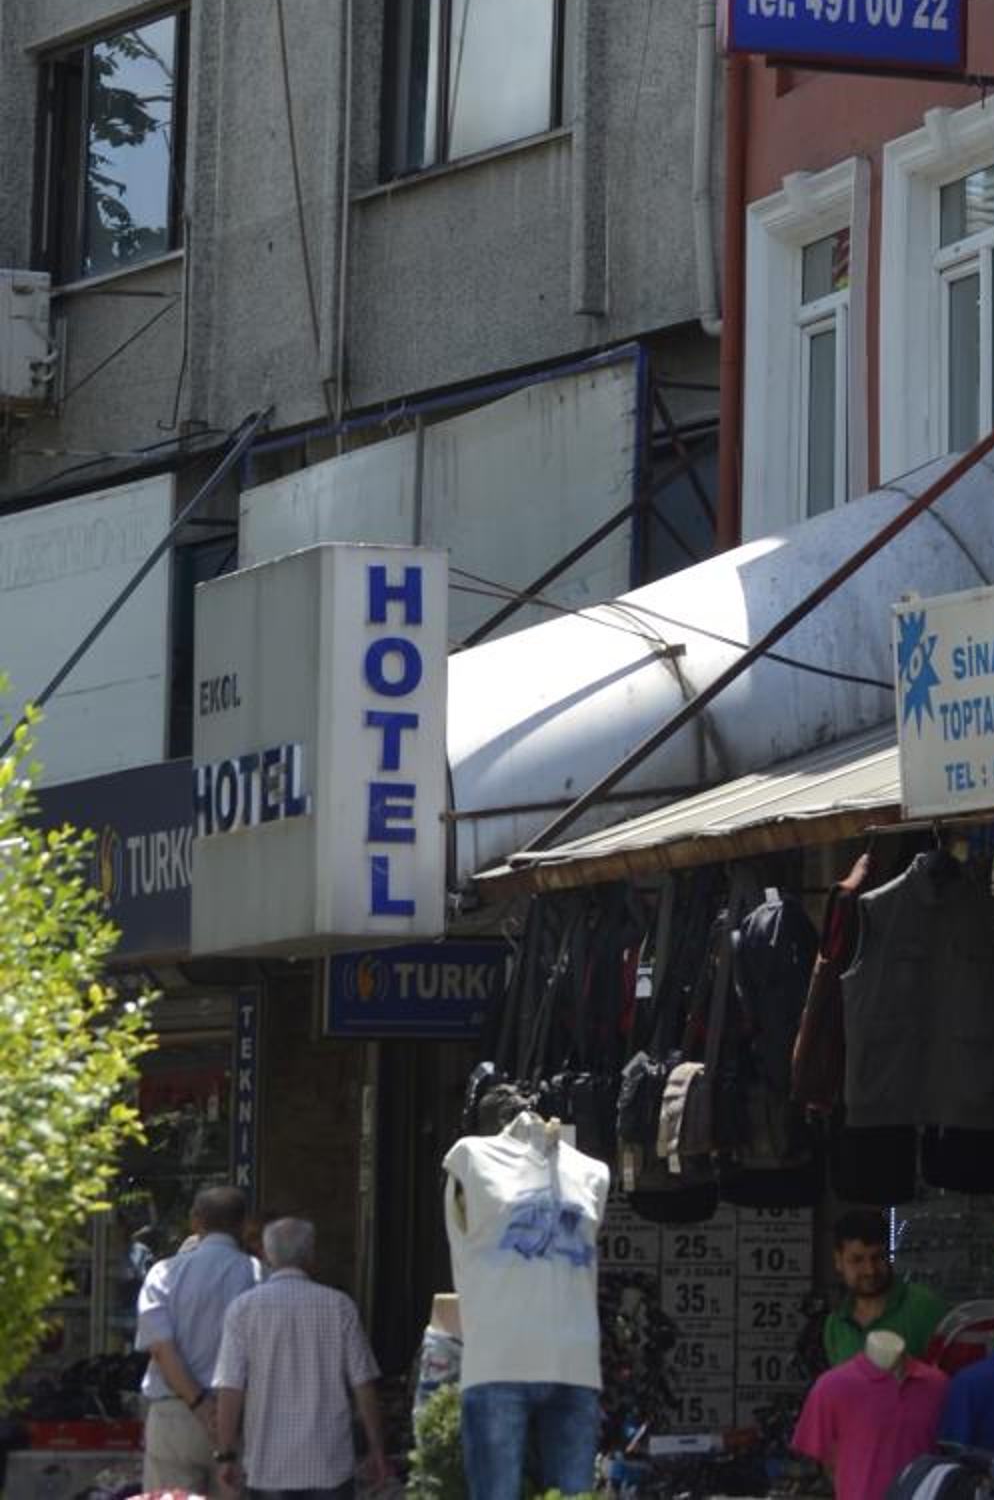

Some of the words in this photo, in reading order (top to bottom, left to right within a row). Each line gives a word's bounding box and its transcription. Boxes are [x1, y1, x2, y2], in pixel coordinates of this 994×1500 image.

[199, 672, 241, 716] EKOL
[363, 565, 423, 917] HOTEL
[193, 744, 307, 837] HOTEL
[674, 1235, 708, 1259] 25
[752, 1247, 785, 1271] 10
[675, 1283, 706, 1314] 35
[752, 1301, 782, 1328] 25
[751, 1355, 782, 1382] 10
